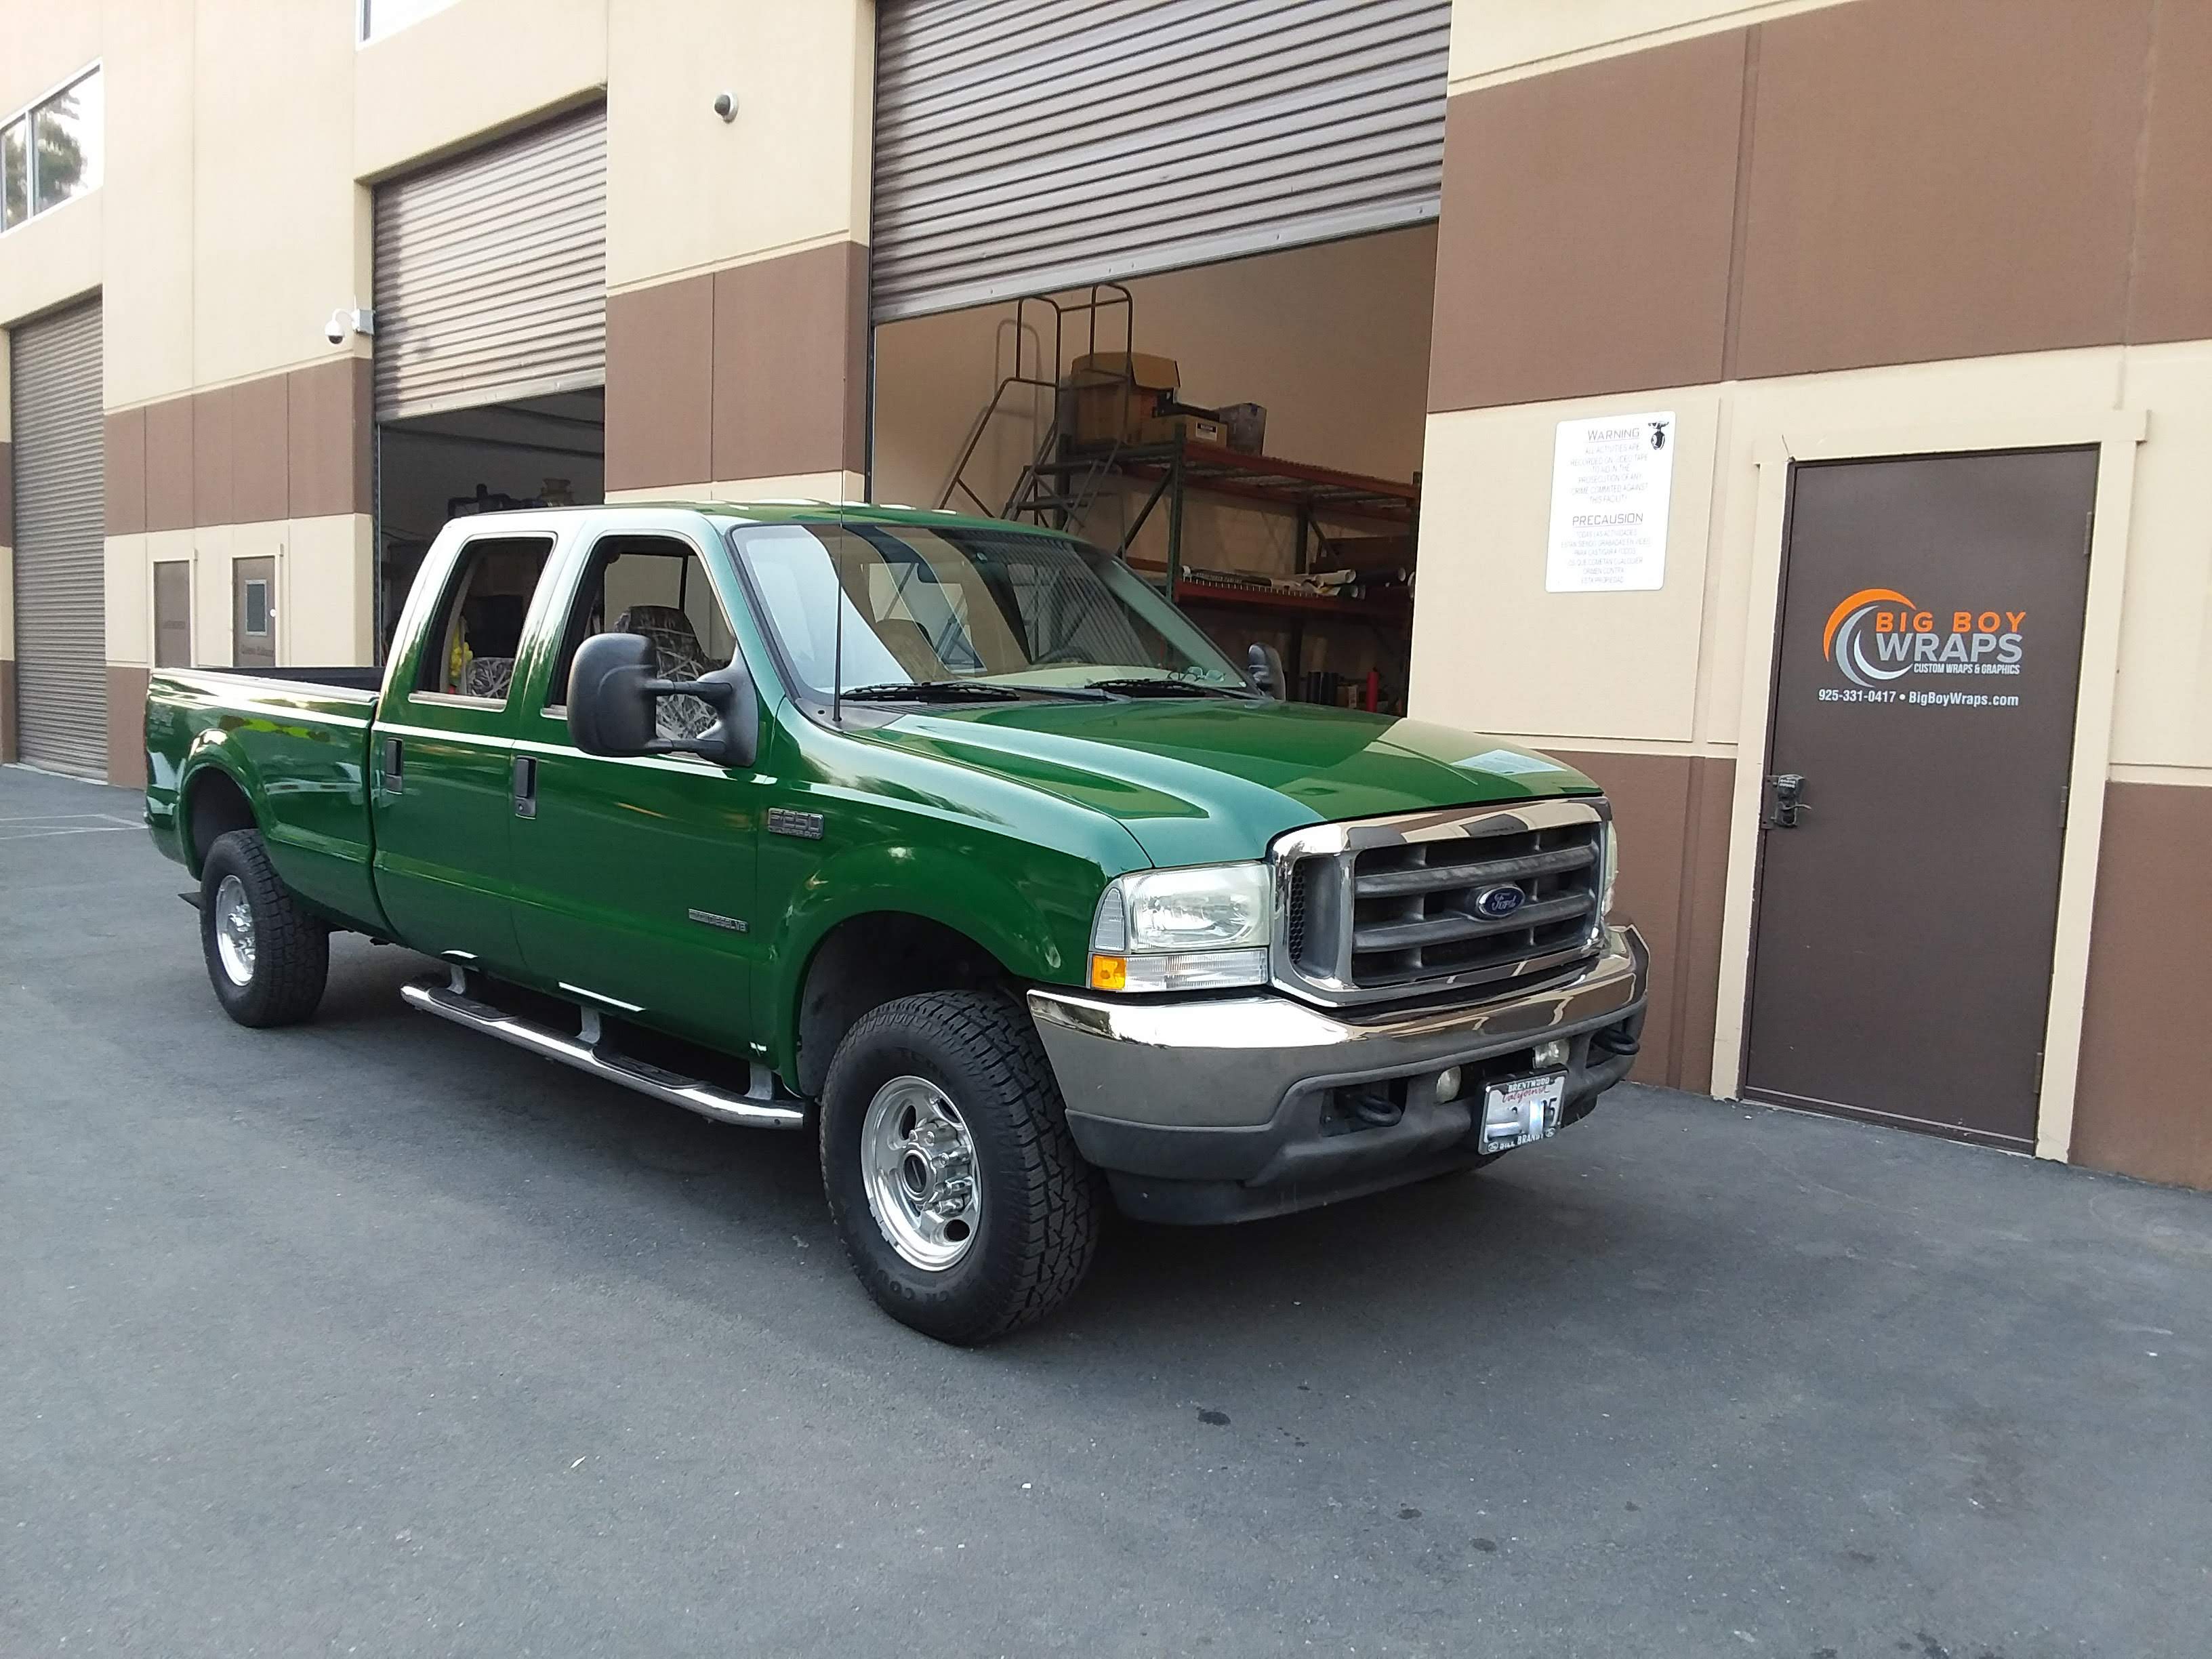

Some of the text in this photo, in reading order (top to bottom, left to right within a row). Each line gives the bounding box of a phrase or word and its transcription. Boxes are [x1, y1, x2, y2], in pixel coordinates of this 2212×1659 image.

[1589, 428, 1640, 441] WARNING
[1572, 512, 1643, 526] PRECAUSION
[1875, 611, 2026, 633] BIG BOY
[1875, 632, 2024, 663] WRAPS
[1913, 663, 2021, 675] CUSTOM WRAPS & GRAPHICS
[1818, 689, 2020, 708] 925-331-0417 BigBoyWraps.com
[1492, 892, 1517, 911] Ford
[1508, 1077, 1551, 1092] BRENTWOOD
